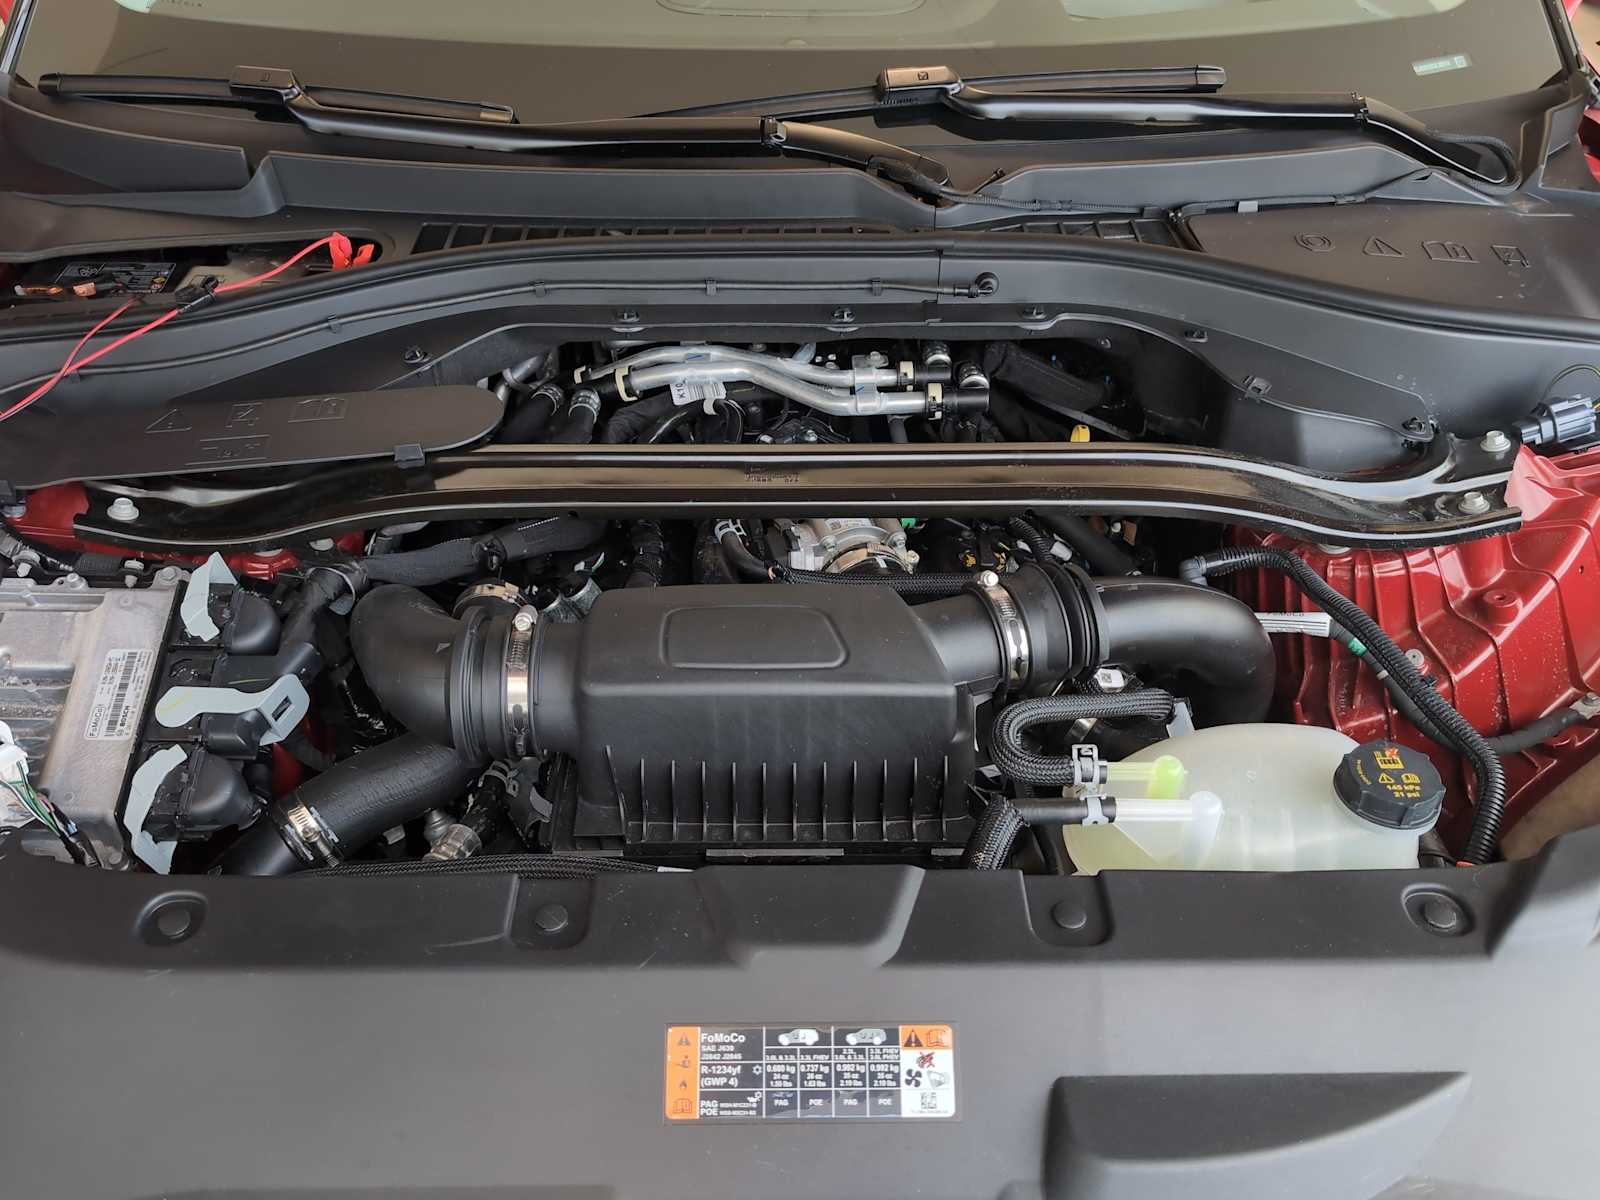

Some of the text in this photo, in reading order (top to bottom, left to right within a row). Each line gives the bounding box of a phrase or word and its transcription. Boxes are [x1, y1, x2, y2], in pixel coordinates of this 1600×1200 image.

[89, 704, 104, 737] FoMoCo
[119, 705, 130, 727] BOSCH
[700, 1032, 747, 1043] FoMoCo
[700, 1065, 741, 1075] R-1234yf
[786, 1064, 796, 1074] kg
[800, 1064, 829, 1073] 0.737 kg
[856, 1064, 866, 1073] kg
[889, 1064, 899, 1073] kg
[700, 1077, 738, 1087] (GWP 4)
[700, 1100, 718, 1108] PAG
[700, 1108, 718, 1116] POE
